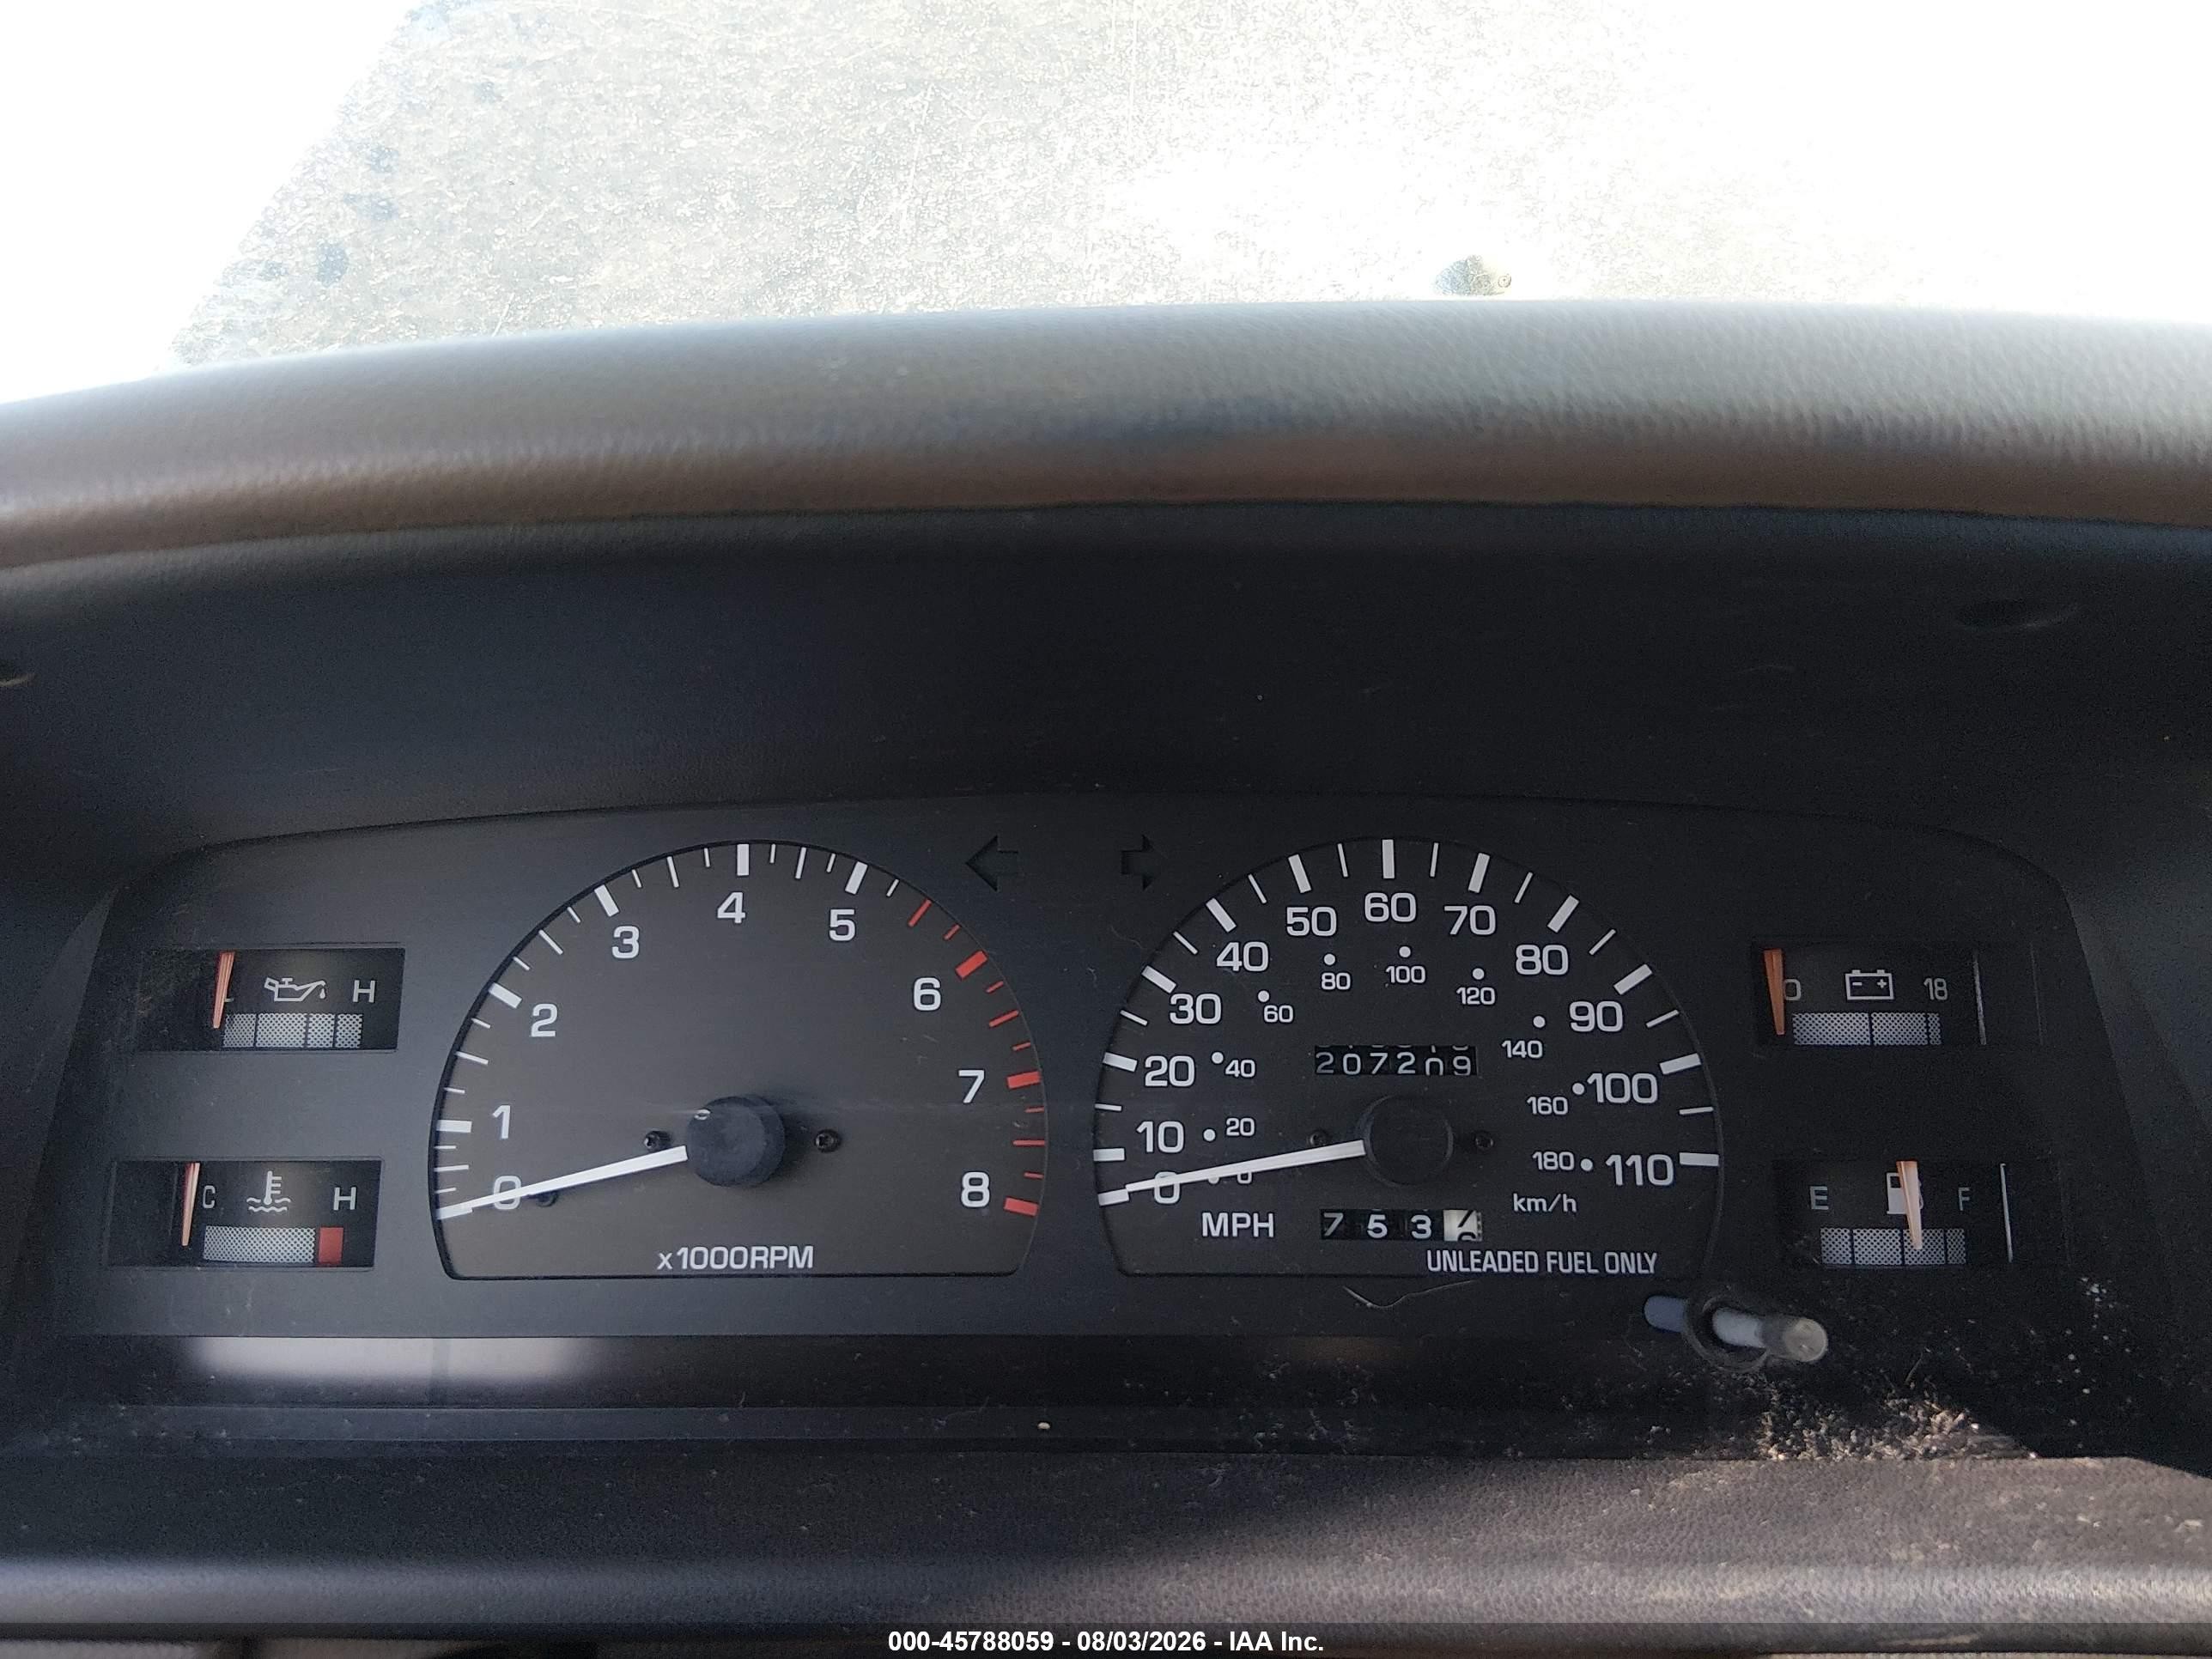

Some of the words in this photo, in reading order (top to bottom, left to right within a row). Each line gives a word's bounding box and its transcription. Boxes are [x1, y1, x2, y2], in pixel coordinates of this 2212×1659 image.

[717, 891, 746, 924] 4
[1286, 906, 1337, 937] 50
[1364, 892, 1417, 922] 60
[1443, 905, 1496, 935] 70
[829, 908, 855, 941] 5
[611, 926, 640, 959] 3
[1216, 941, 1269, 972] 40
[1385, 965, 1426, 984] 100
[1516, 944, 1569, 975] 80
[352, 979, 376, 1003] H
[913, 977, 941, 1012] 6
[1321, 972, 1351, 990] 80
[1923, 977, 1948, 1000] 18
[1169, 994, 1222, 1024] 30
[1455, 987, 1496, 1006] 120
[531, 1003, 558, 1038] 2
[1263, 1005, 1294, 1023] 60
[1569, 1000, 1624, 1032] 90
[1501, 1040, 1543, 1059] 140
[1145, 1055, 1195, 1087] 20
[1224, 1059, 1255, 1078] 40
[958, 1069, 985, 1103] 7
[1586, 1073, 1659, 1105] 100
[1526, 1096, 1569, 1115] 160
[491, 1104, 511, 1139] 1
[1225, 1117, 1255, 1137] 20
[1136, 1121, 1184, 1153] 10
[1532, 1151, 1575, 1171] 180
[1605, 1153, 1674, 1186] 110
[202, 1185, 216, 1209] C
[332, 1187, 356, 1211] H
[493, 1175, 522, 1211] 0
[960, 1171, 990, 1208] 8
[1513, 1193, 1577, 1212] km/h
[1809, 1185, 1830, 1211] E
[1958, 1187, 1971, 1212] F
[1201, 1212, 1274, 1238] MPH
[656, 1245, 814, 1270] x1000RPM
[1426, 1249, 1539, 1273] UNLEADED
[1546, 1250, 1600, 1274] FUEL
[1604, 1251, 1657, 1274] ONLY
